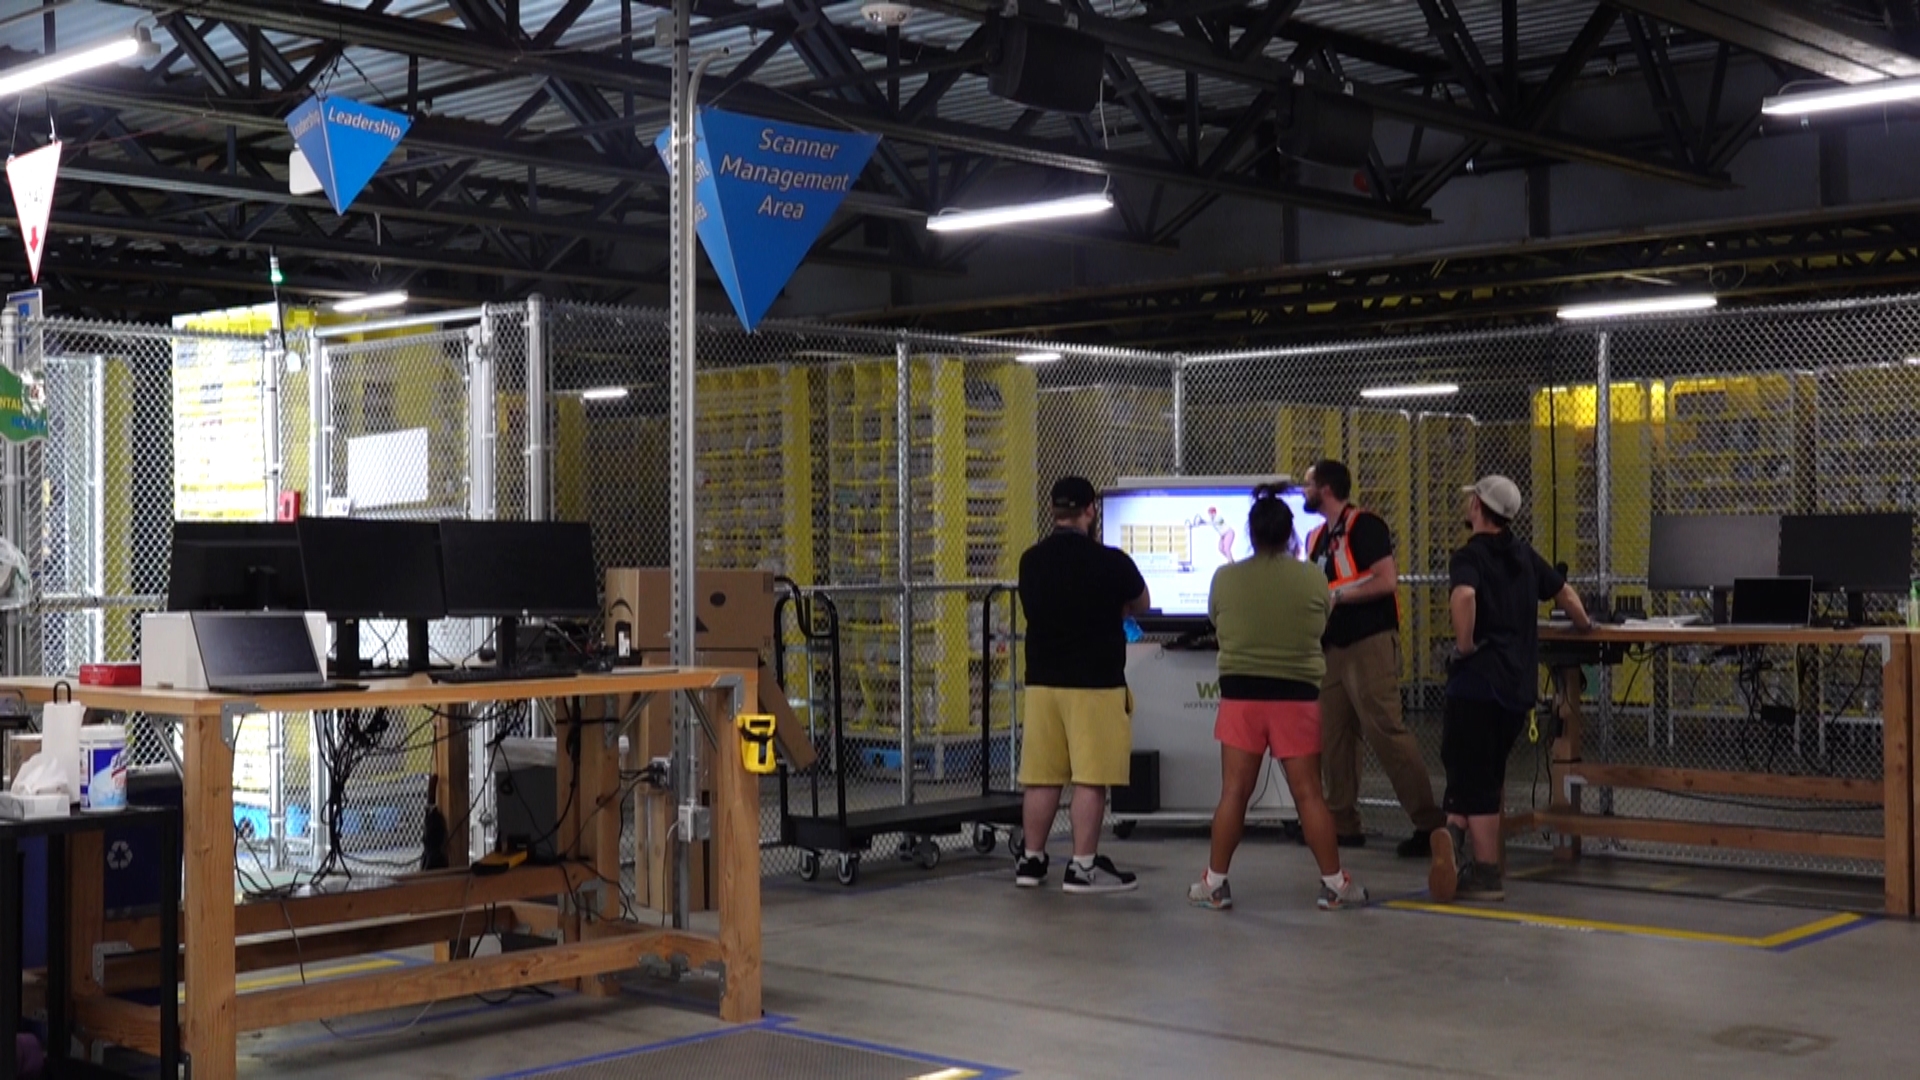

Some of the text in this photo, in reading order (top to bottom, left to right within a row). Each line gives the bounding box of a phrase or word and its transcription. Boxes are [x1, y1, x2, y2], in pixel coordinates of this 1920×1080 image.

[328, 106, 401, 141] Leadership
[758, 128, 839, 160] Scanner
[719, 154, 849, 192] Management
[758, 194, 804, 219] Area
